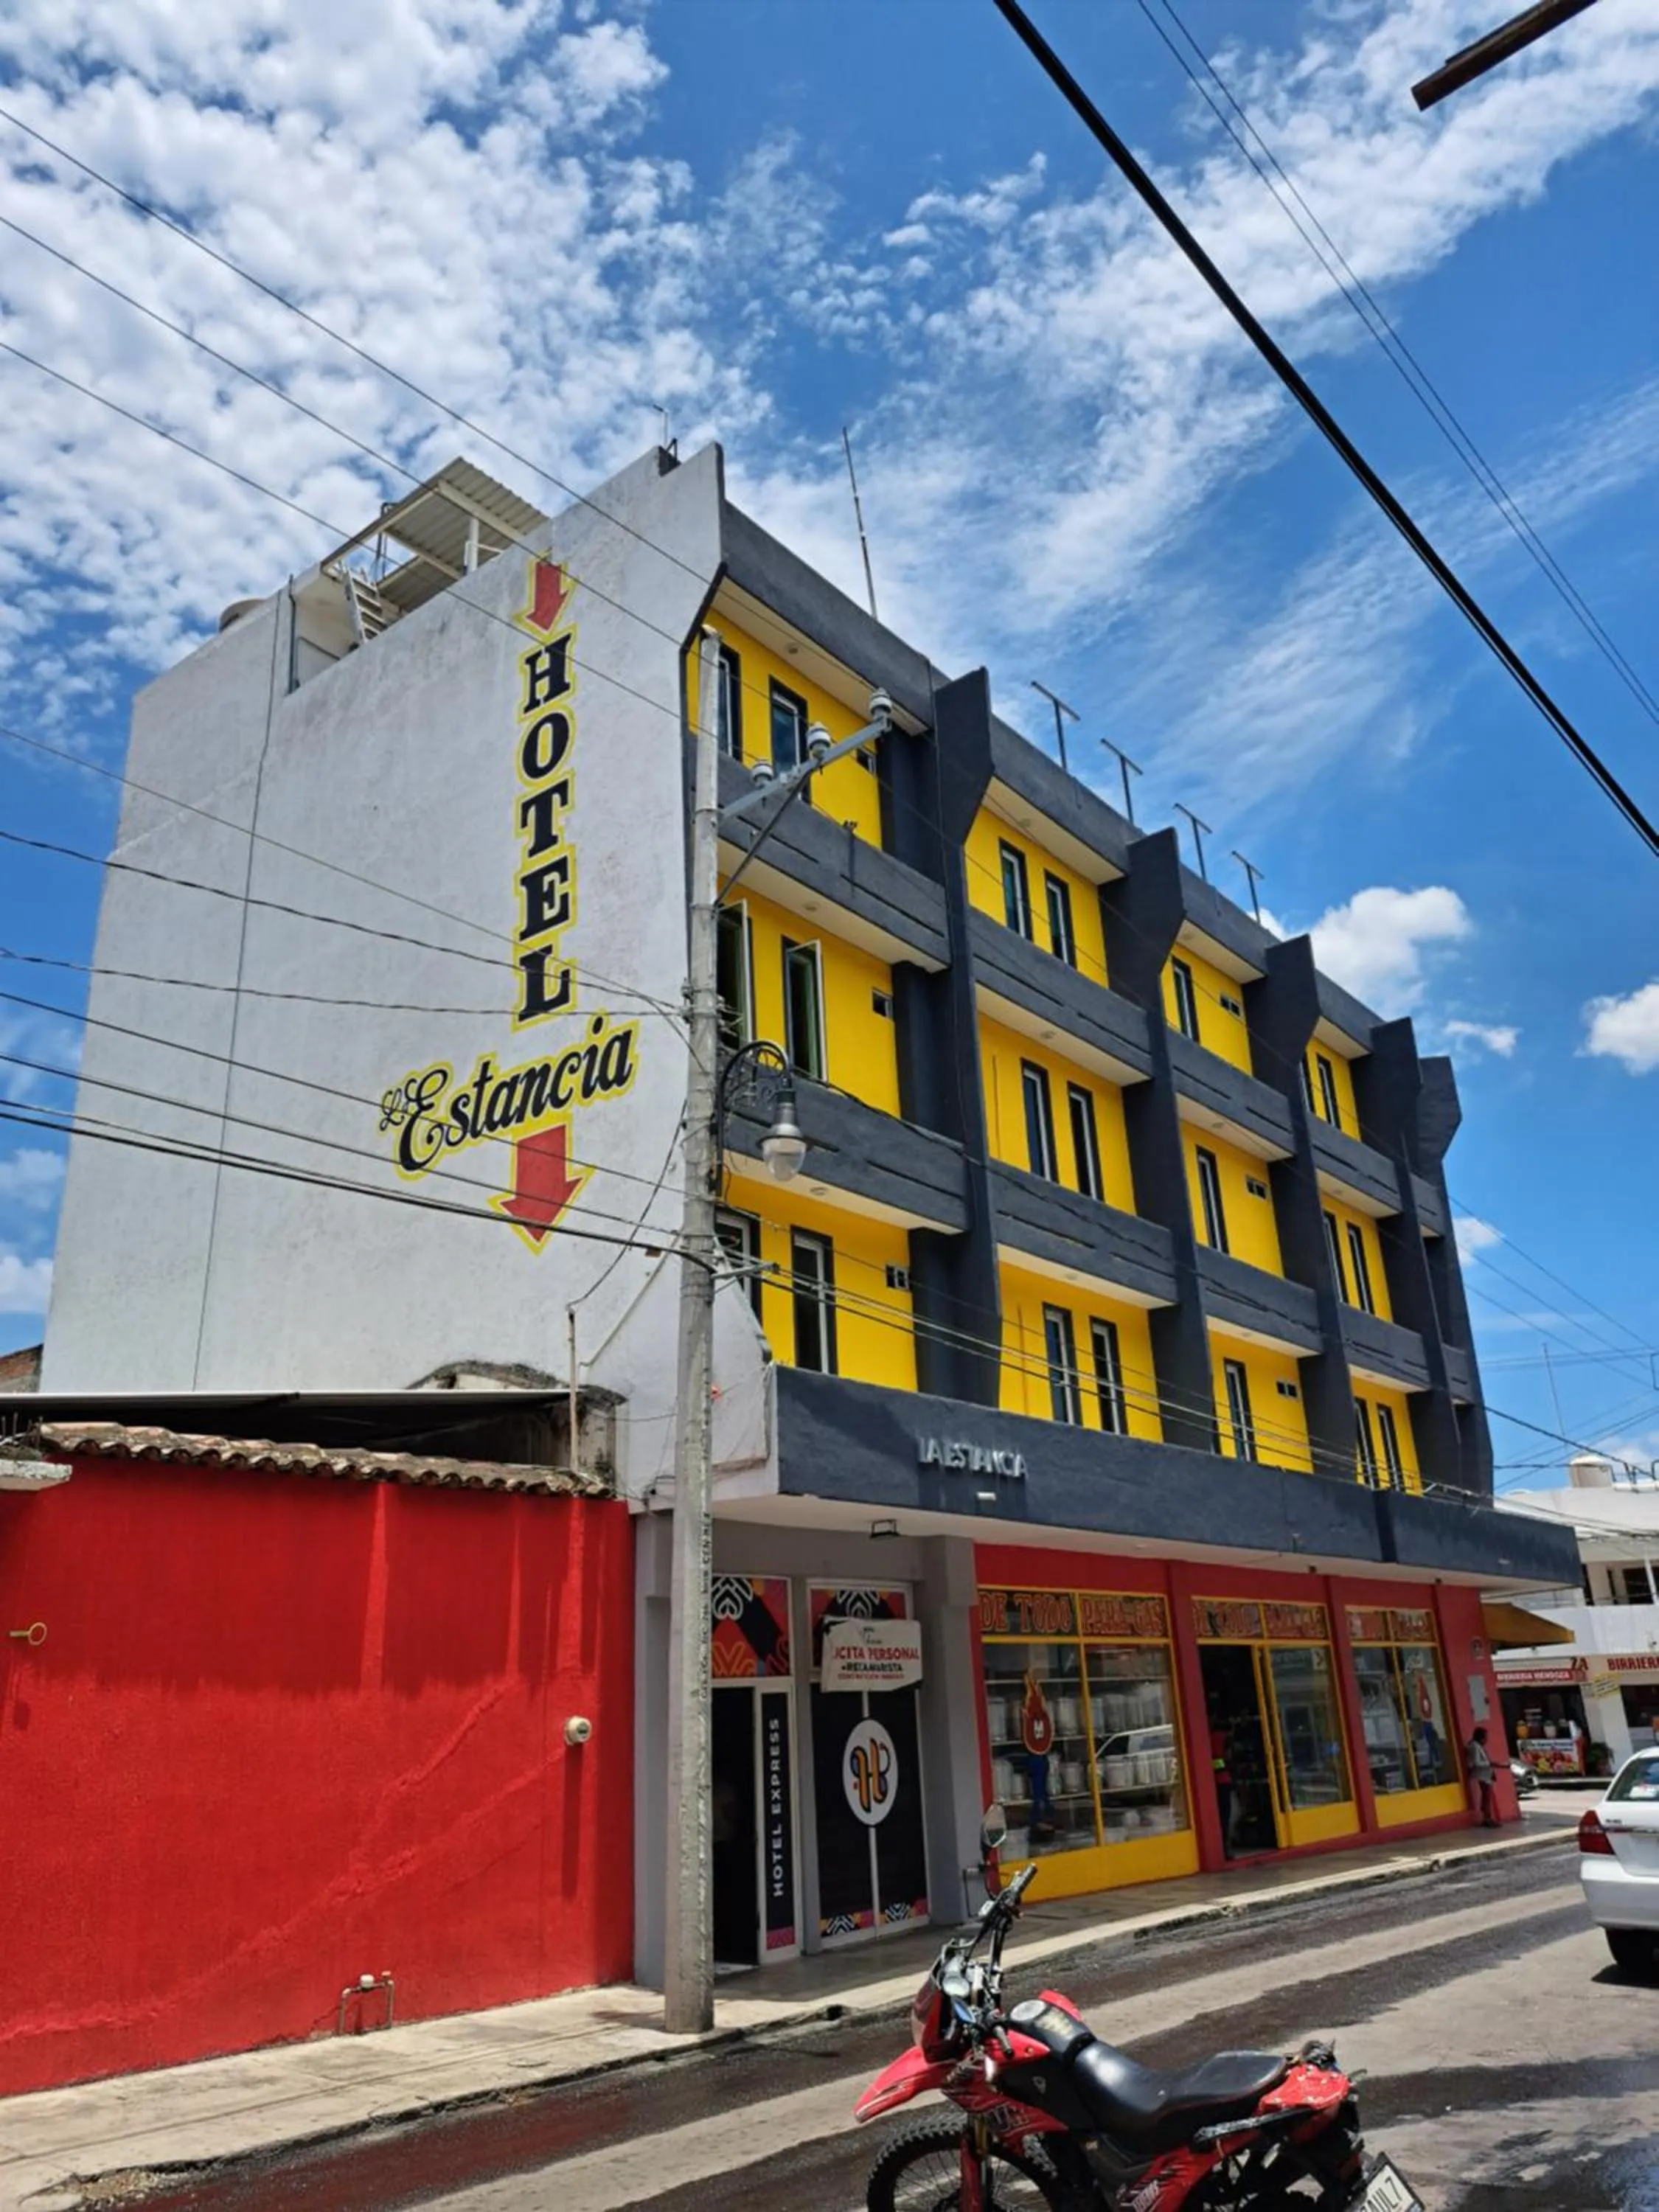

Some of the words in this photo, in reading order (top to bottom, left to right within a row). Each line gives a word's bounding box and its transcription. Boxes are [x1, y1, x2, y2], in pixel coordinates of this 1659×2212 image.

[519, 633, 571, 1022] HOTEL
[399, 1017, 633, 1171] Estancia
[979, 1592, 1008, 1632] DE
[769, 1719, 782, 1815] EXPRESS
[772, 1823, 784, 1897] HOTEL
